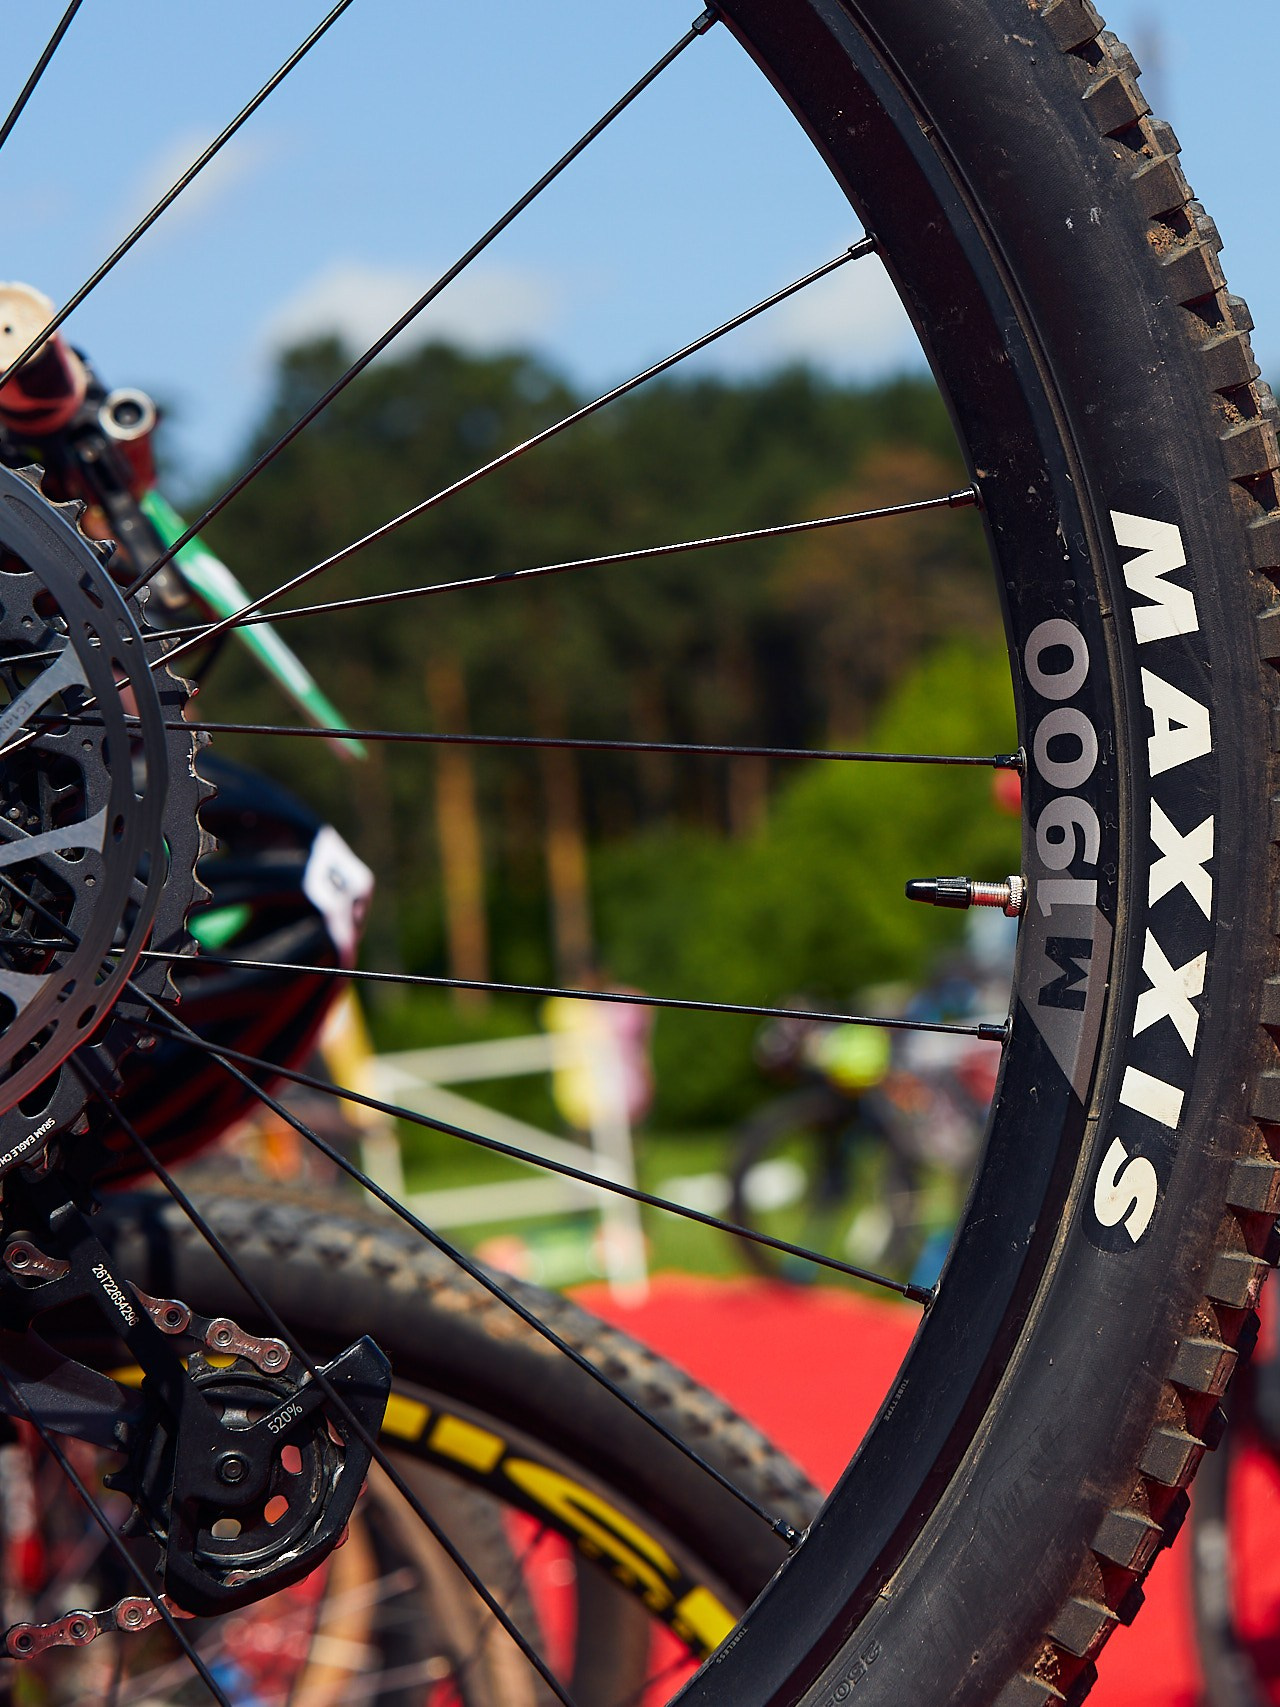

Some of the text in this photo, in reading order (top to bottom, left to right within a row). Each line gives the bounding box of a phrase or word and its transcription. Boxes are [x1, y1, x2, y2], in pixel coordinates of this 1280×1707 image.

[1093, 509, 1214, 1244] MAXXIS
[10, 1134, 37, 1158] EAGLE
[33, 1117, 56, 1139] SRAM
[91, 1263, 140, 1327] 26T22654296
[883, 1378, 910, 1421] TUBE TYPE
[267, 1403, 303, 1434] 520%
[715, 1627, 749, 1664] TUBELESS
